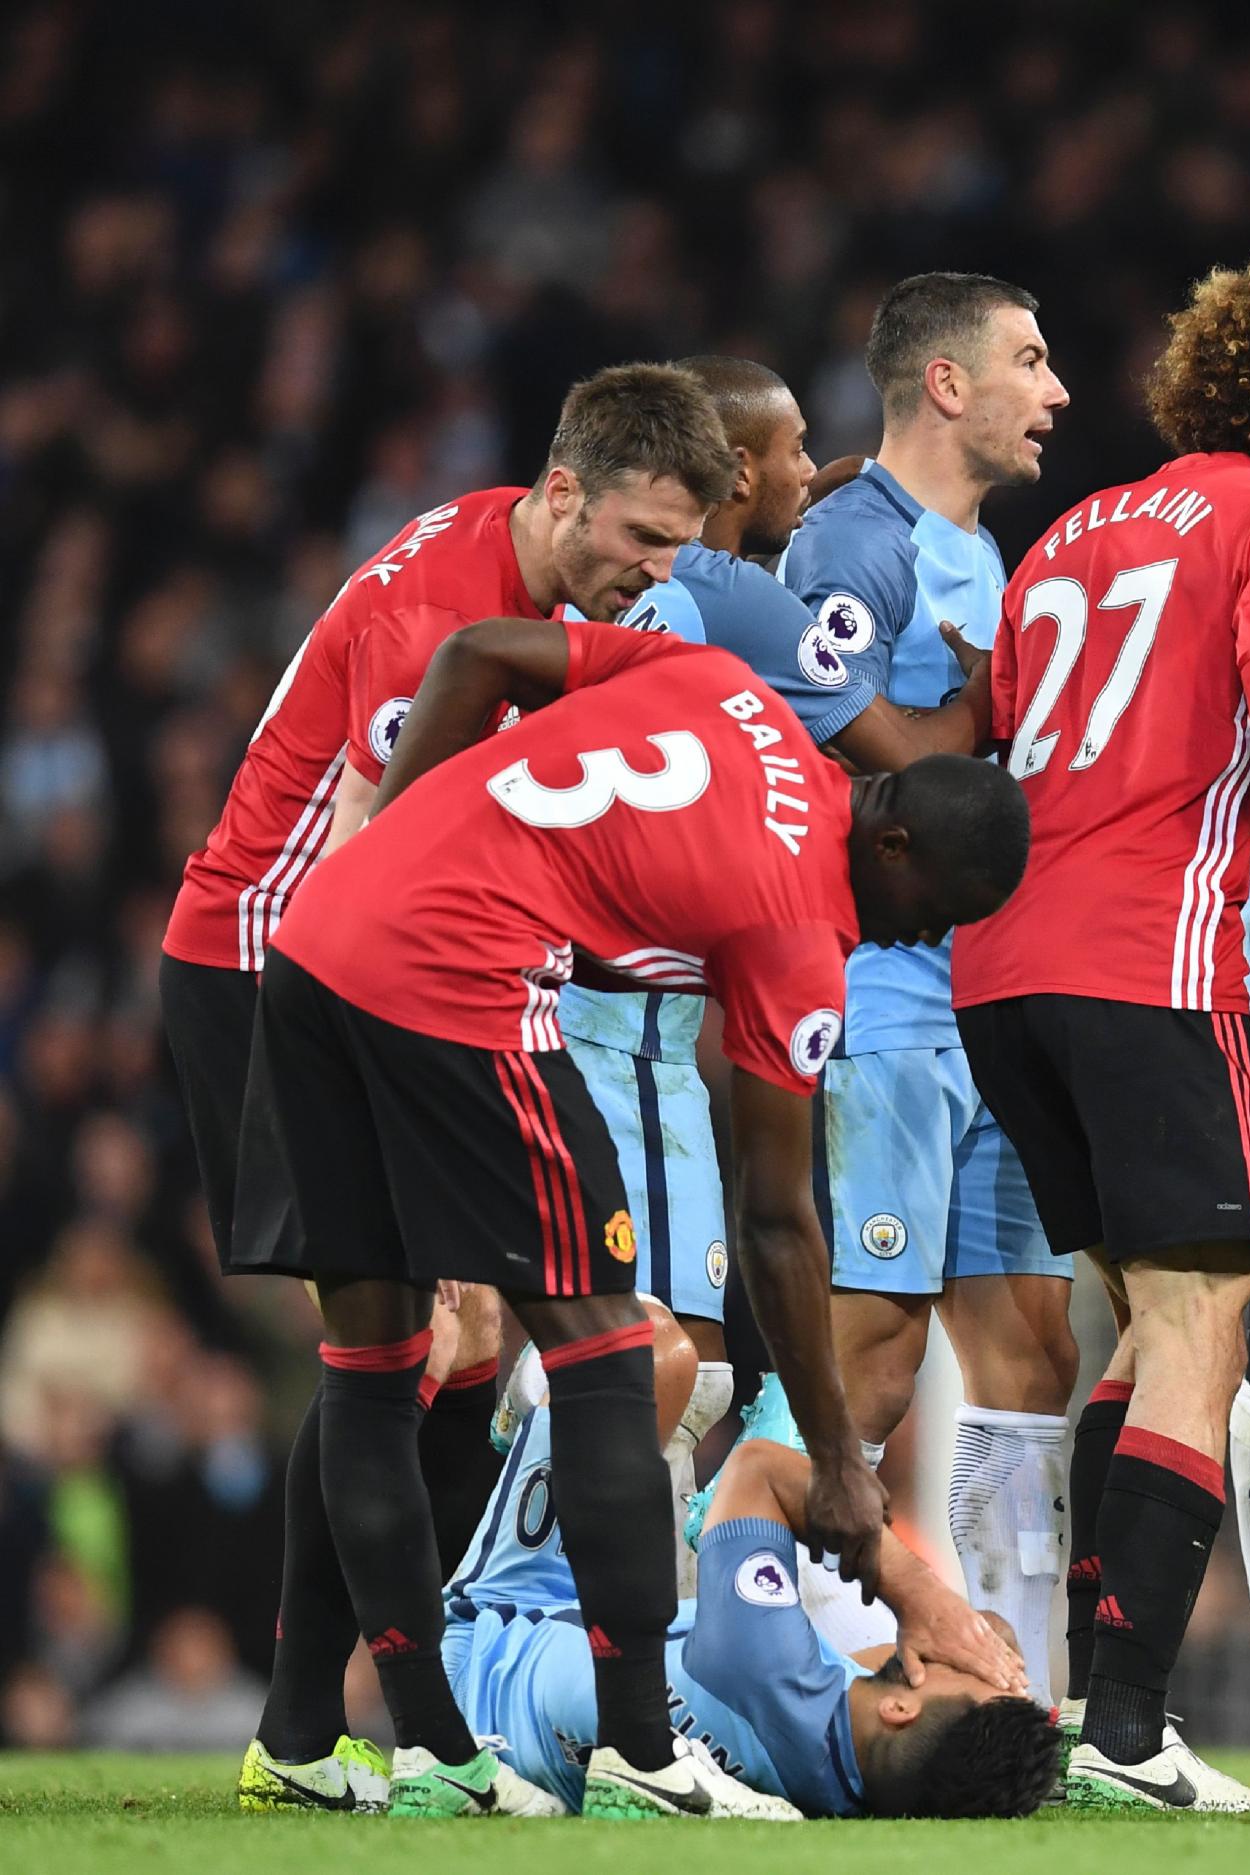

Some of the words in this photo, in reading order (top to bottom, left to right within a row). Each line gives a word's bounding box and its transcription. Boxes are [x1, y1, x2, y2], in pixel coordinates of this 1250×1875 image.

[1043, 487, 1214, 560] FELLAINI
[1007, 557, 1179, 783] 27
[486, 730, 712, 829] 3
[719, 689, 809, 856] BAILLY
